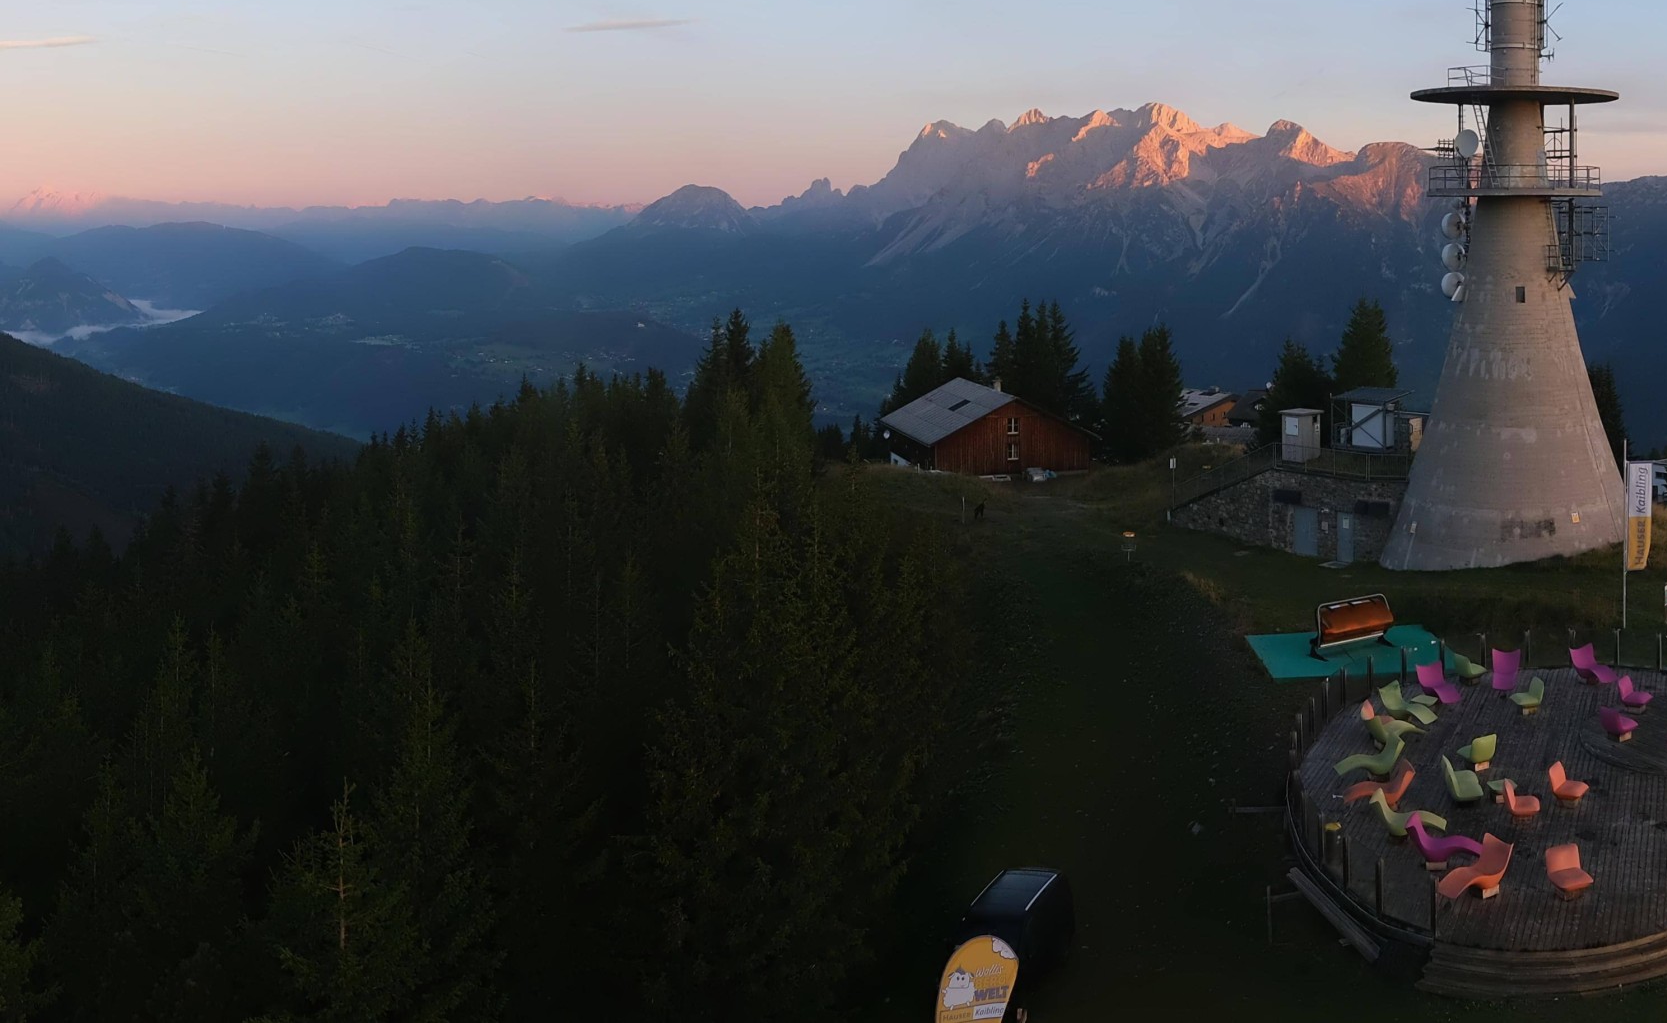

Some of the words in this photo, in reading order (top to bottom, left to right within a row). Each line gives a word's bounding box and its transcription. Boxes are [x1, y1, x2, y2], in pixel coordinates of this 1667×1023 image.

[1636, 467, 1648, 514] Kaibling
[1635, 520, 1646, 566] HAUSER
[974, 986, 1009, 1001] WELT
[975, 1007, 1004, 1016] Kaibling
